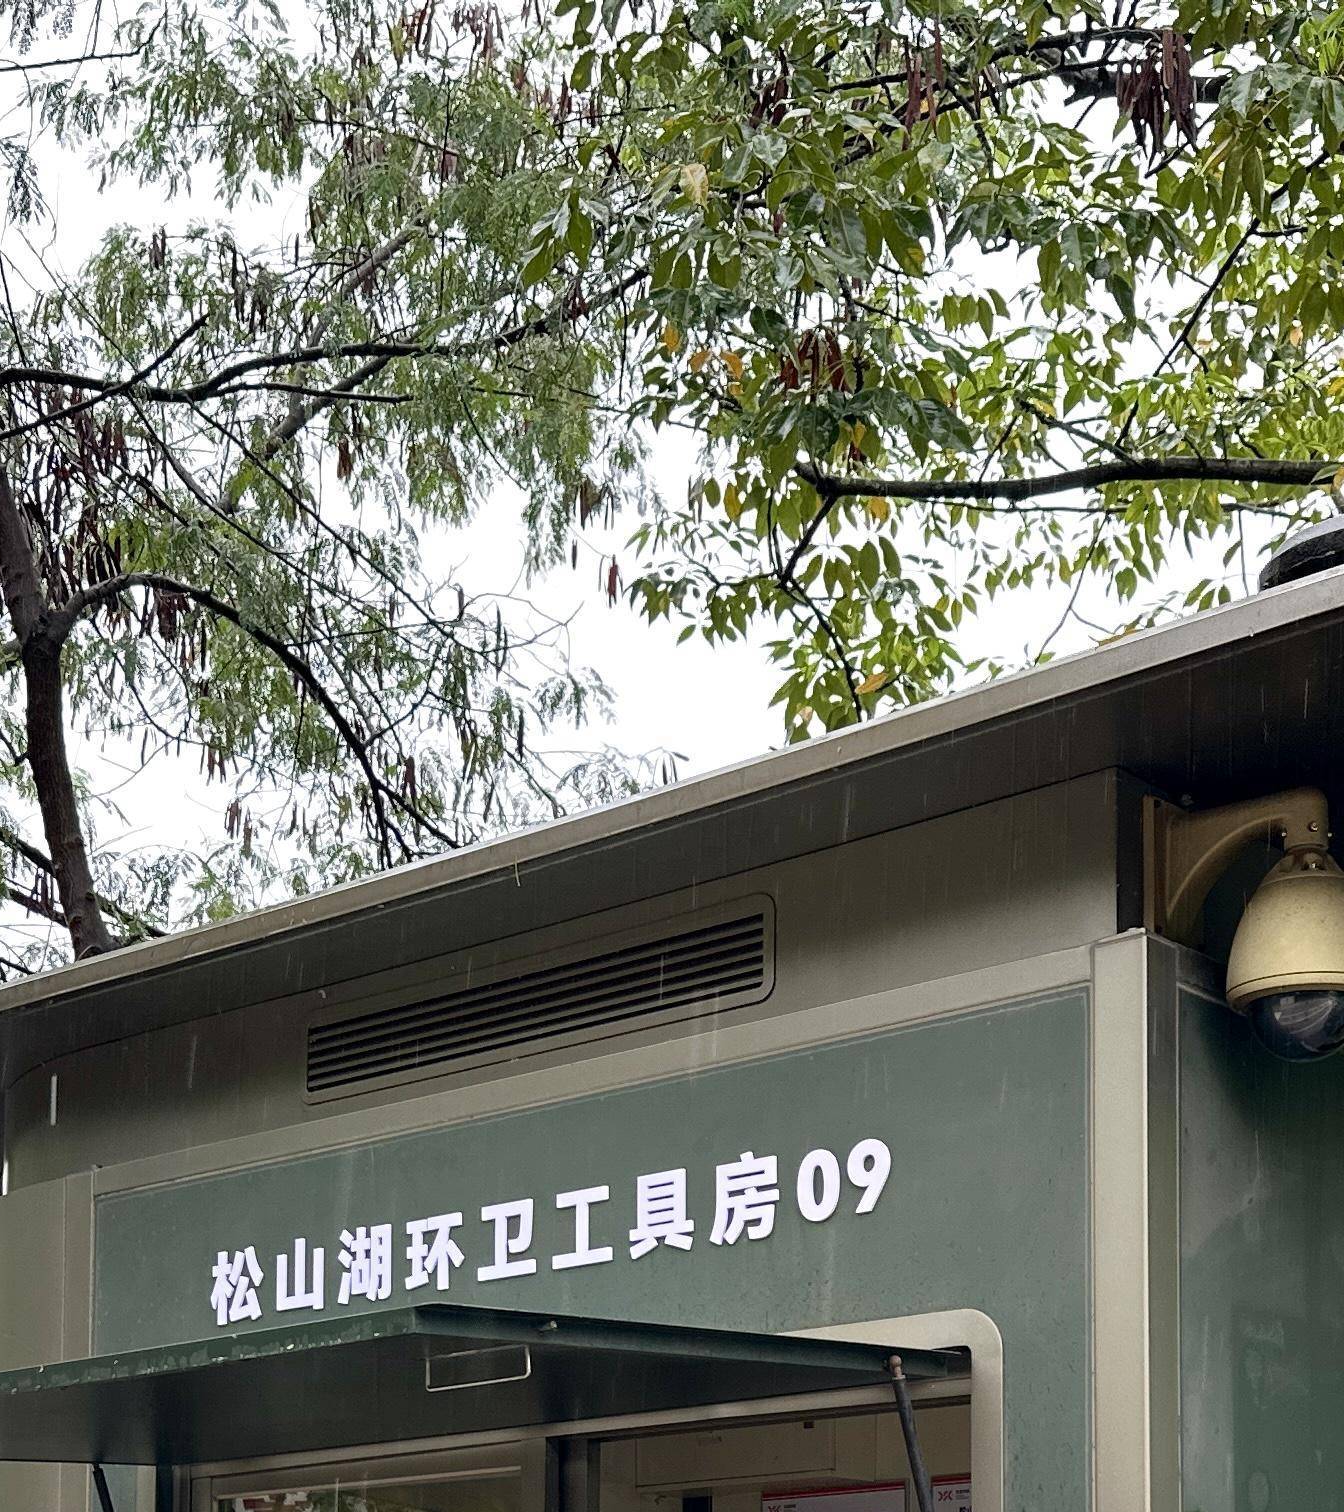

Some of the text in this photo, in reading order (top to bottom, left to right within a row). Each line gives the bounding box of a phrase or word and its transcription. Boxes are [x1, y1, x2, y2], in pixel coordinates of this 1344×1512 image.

[211, 1138, 893, 1326] 松山湖环卫工具房09
